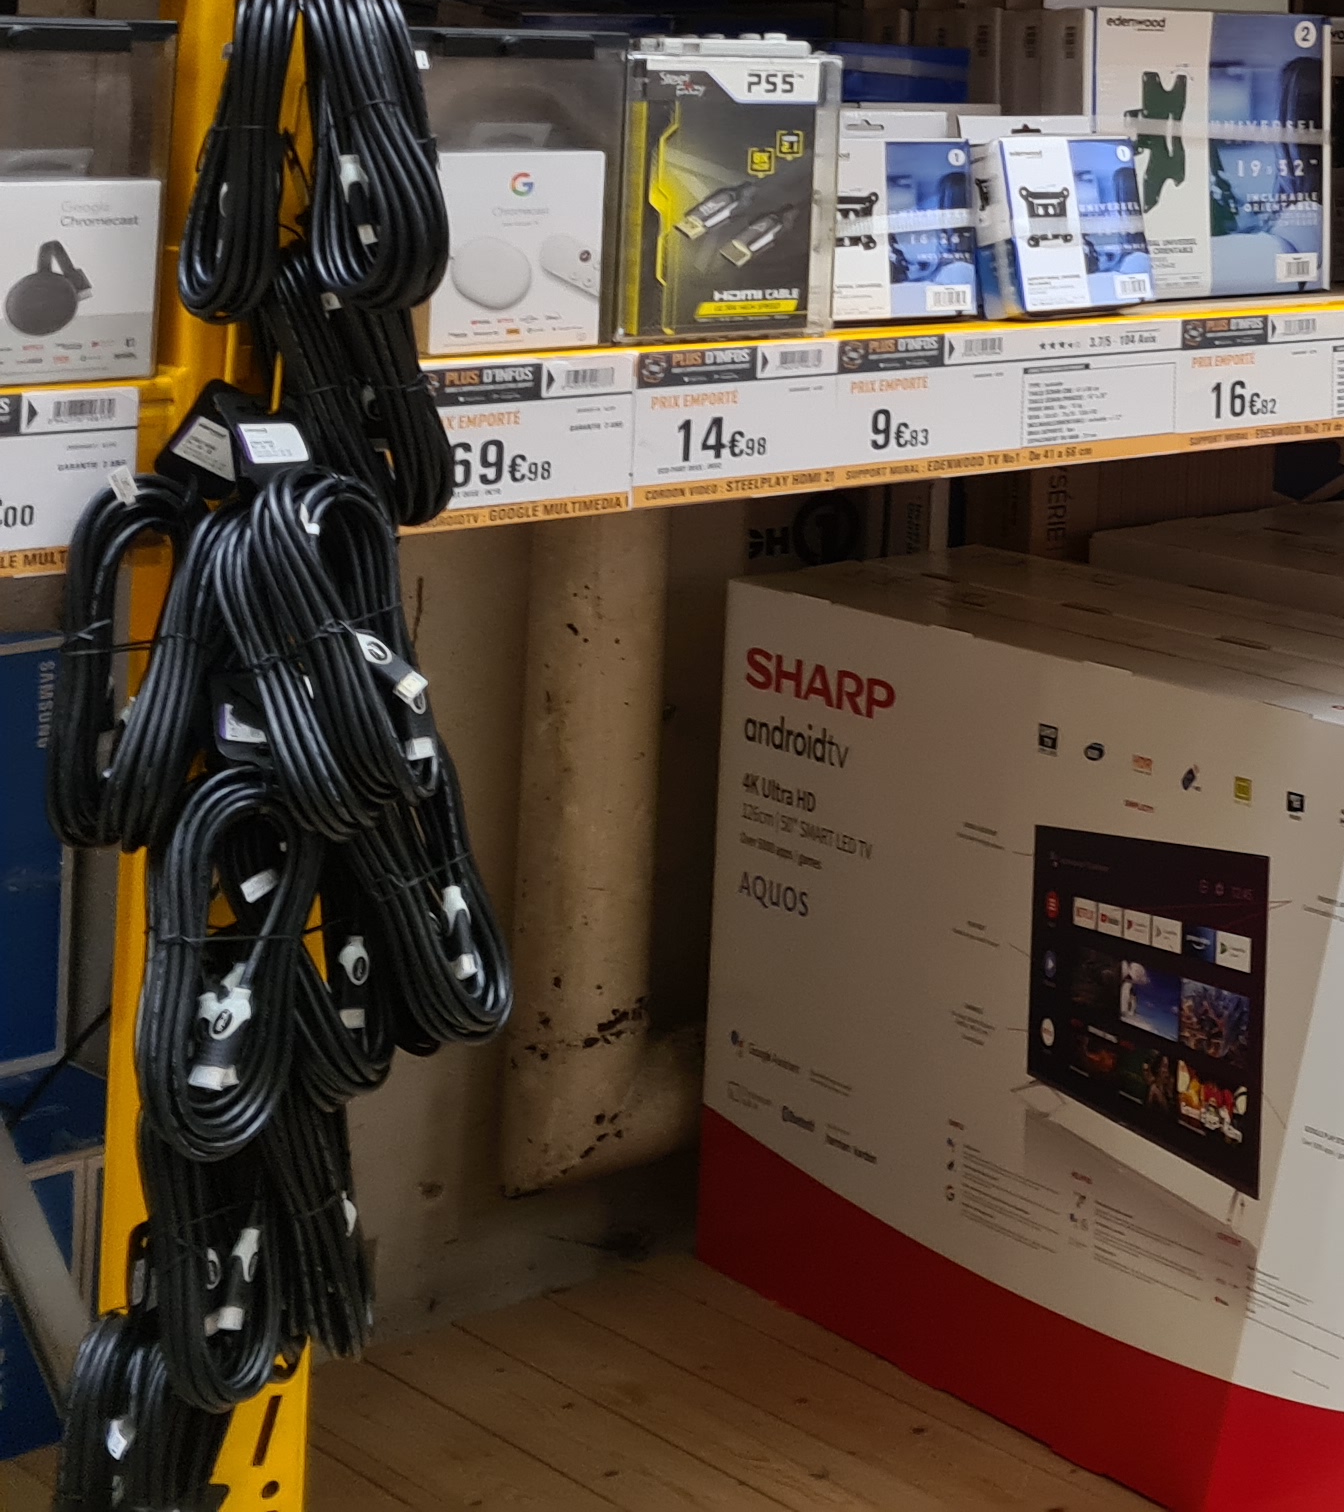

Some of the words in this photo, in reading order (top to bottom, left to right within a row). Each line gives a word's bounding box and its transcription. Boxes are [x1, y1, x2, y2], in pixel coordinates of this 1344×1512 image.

[748, 73, 795, 94] PS5
[60, 213, 139, 228] Chromecast
[705, 349, 751, 365] D'INFOS
[445, 370, 480, 385] PLUS
[483, 366, 534, 383] D'INFOS
[651, 395, 680, 410] PRIX
[683, 389, 739, 408] EMPORTÉ
[1212, 380, 1277, 419] 16€82
[460, 410, 521, 428] EMPORTÉ
[871, 409, 929, 450] 9€83
[677, 416, 767, 462] 14€98
[452, 439, 552, 488] 69€98
[928, 452, 985, 472] EDENWOOD
[726, 474, 790, 493] STEELPLAY
[489, 503, 540, 522] GOOGLE
[542, 496, 622, 516] MULTIMEDIA
[746, 647, 895, 718] SHARP
[745, 716, 848, 768] androidtv
[742, 773, 760, 795] 4K
[762, 777, 794, 805] Ultra
[797, 790, 816, 812] HD
[738, 872, 809, 916] AQUOS
